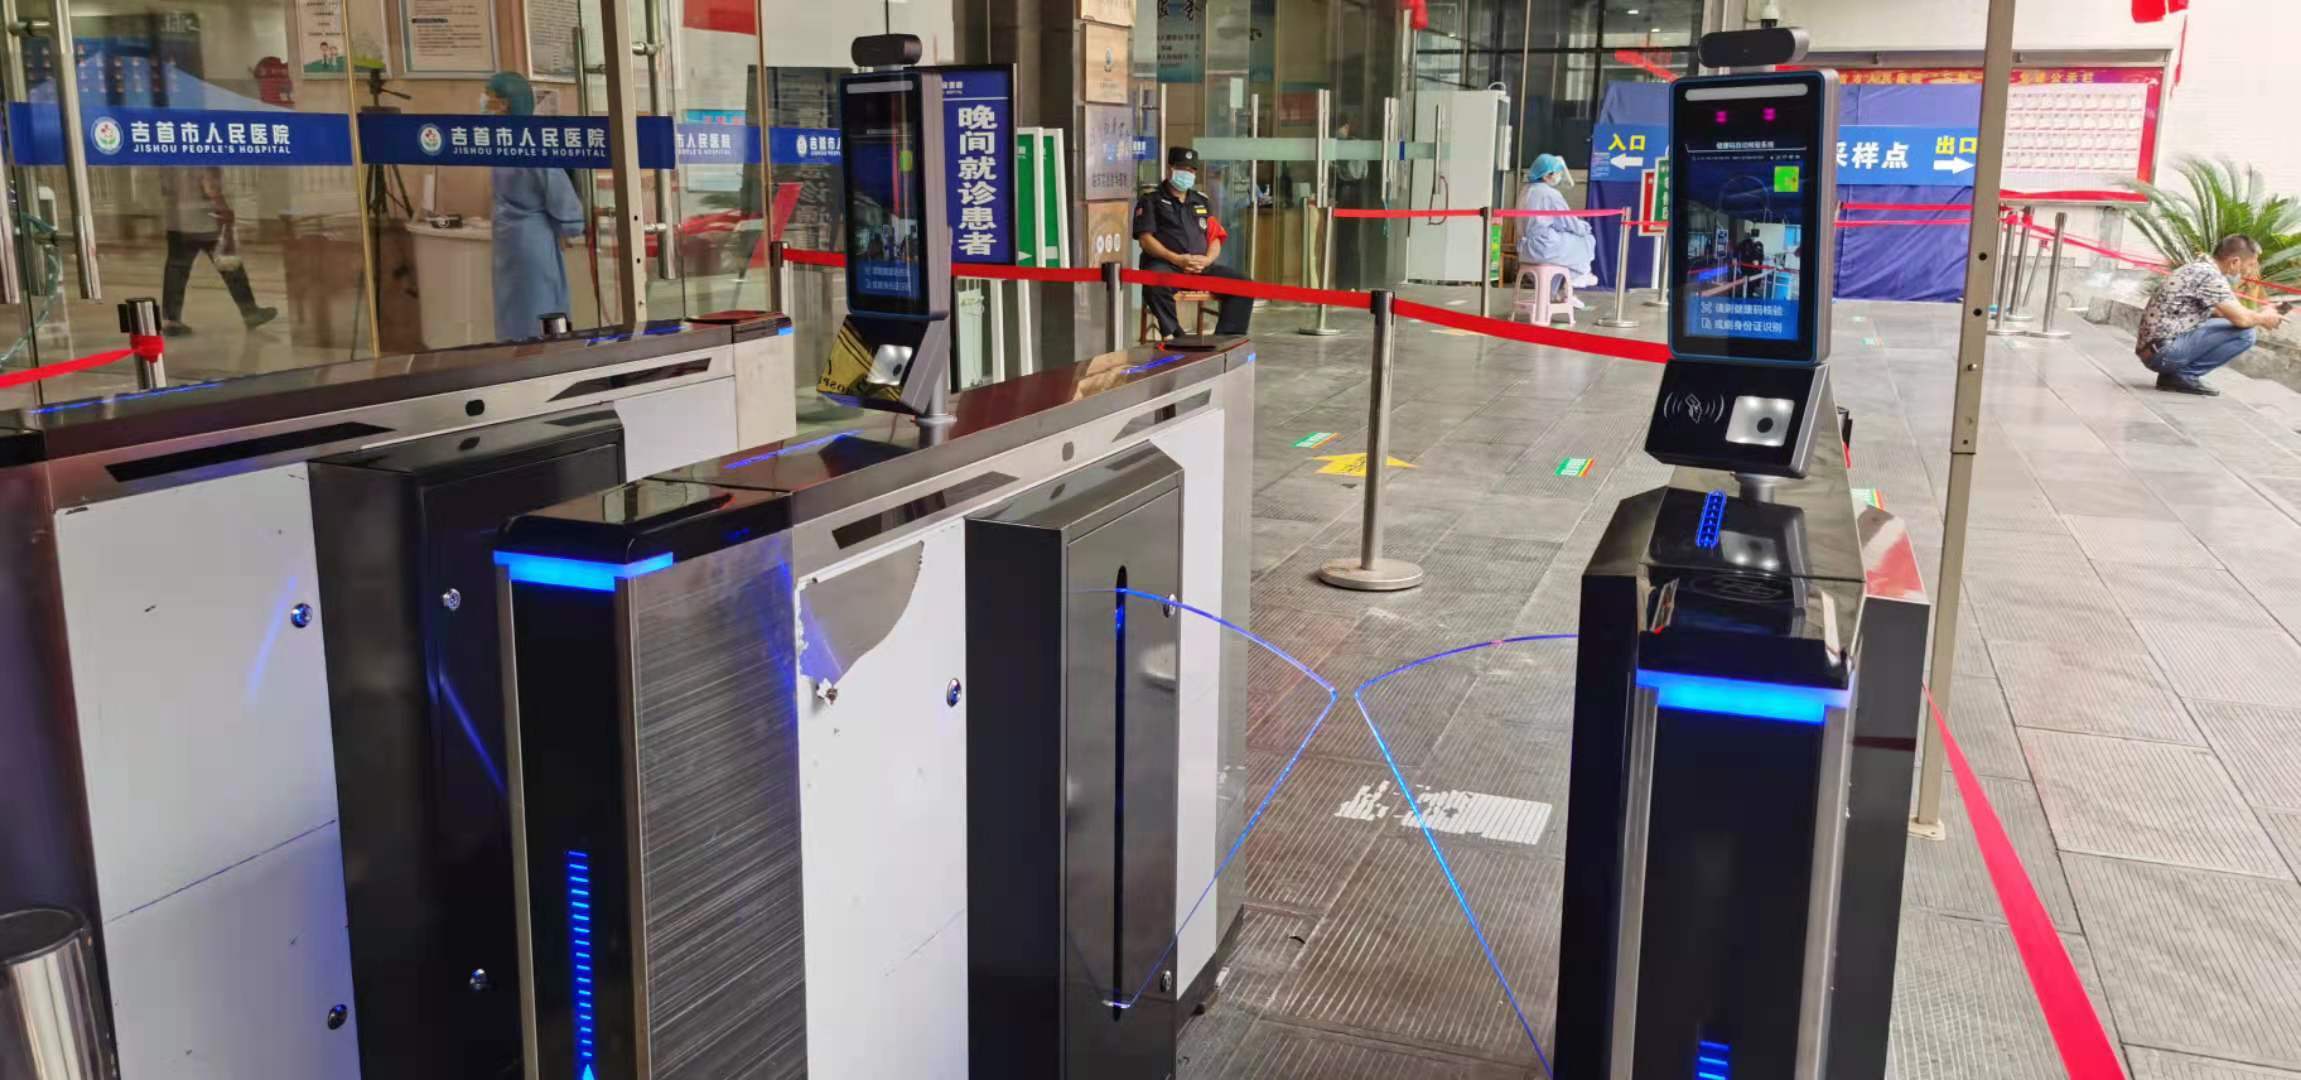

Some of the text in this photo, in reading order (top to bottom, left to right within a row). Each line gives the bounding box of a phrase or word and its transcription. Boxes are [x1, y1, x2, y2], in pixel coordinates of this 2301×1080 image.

[130, 121, 291, 145] 吉首市人民医院
[450, 127, 607, 148] 吉首市人民医院
[1607, 132, 1647, 151] 入口
[133, 144, 178, 154] JISHOU
[239, 145, 292, 155] HOSPITAL
[453, 146, 493, 156] JISHOU
[552, 148, 607, 158] HOSPITAL
[1935, 135, 1978, 155] 出口
[957, 104, 998, 256] 晚间就诊患者
